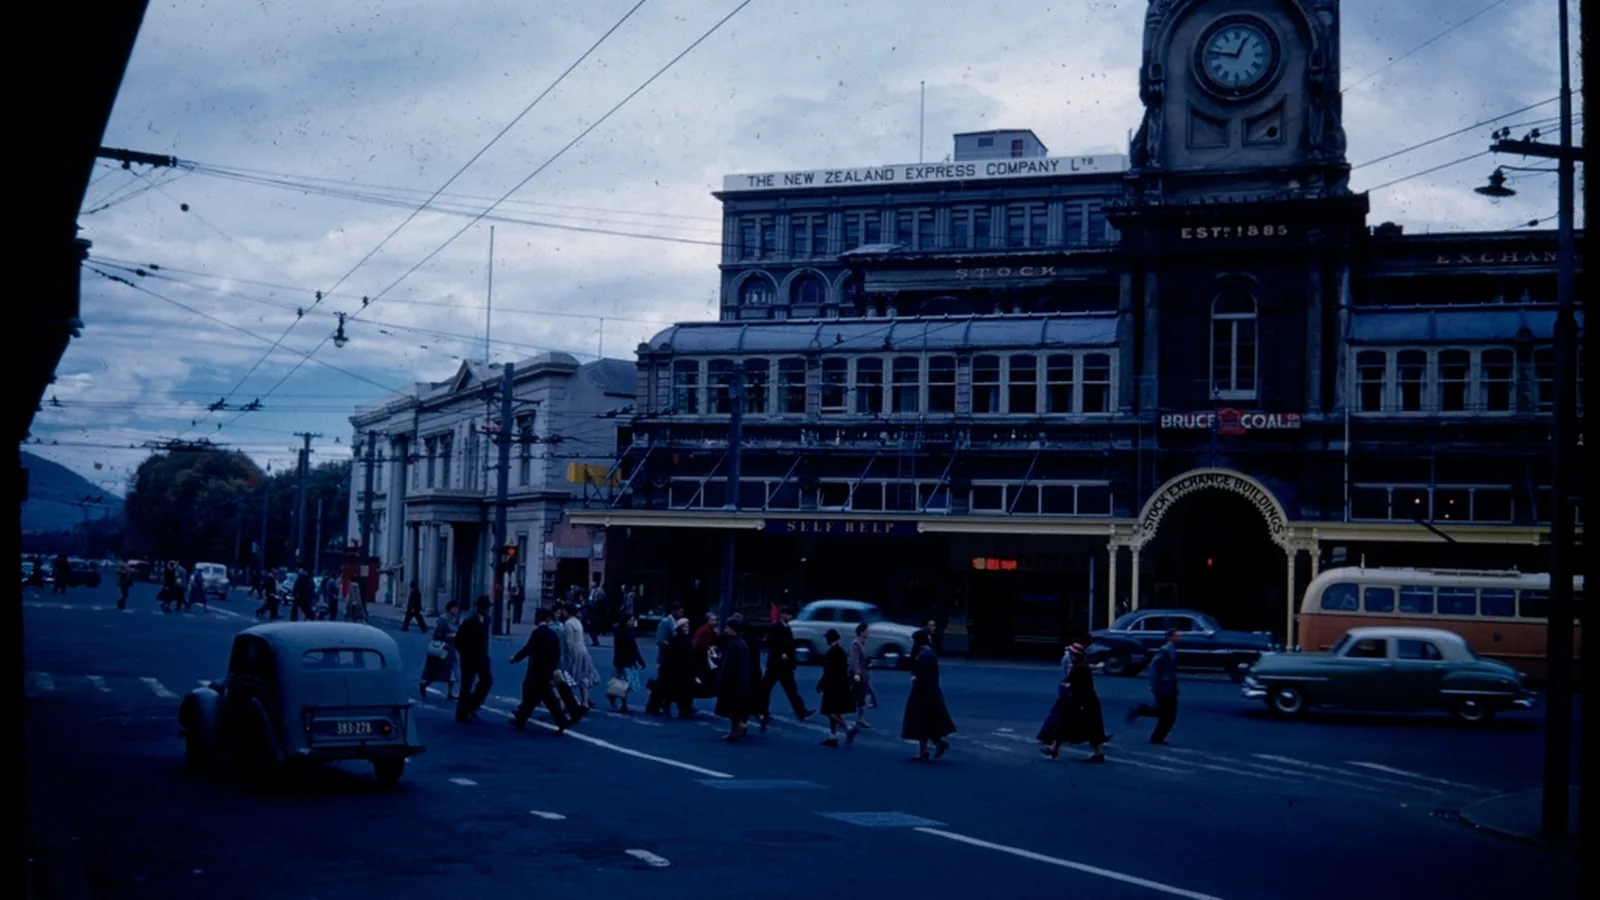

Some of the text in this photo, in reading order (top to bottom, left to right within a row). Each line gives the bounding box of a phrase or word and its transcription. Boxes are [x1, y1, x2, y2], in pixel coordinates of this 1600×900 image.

[748, 174, 775, 187] THE
[784, 172, 815, 186] NEW
[825, 168, 894, 184] ZEALAND
[905, 163, 976, 180] EXPRESS
[986, 159, 1059, 176] COMPANY
[1236, 224, 1288, 238] 1885
[955, 265, 1057, 281] STOCK
[1160, 413, 1216, 429] BRUCE
[1240, 413, 1287, 429] COAL
[1143, 474, 1285, 535] STOCK EXCHANGE BUILDINGS
[786, 520, 895, 534] SELF HELP
